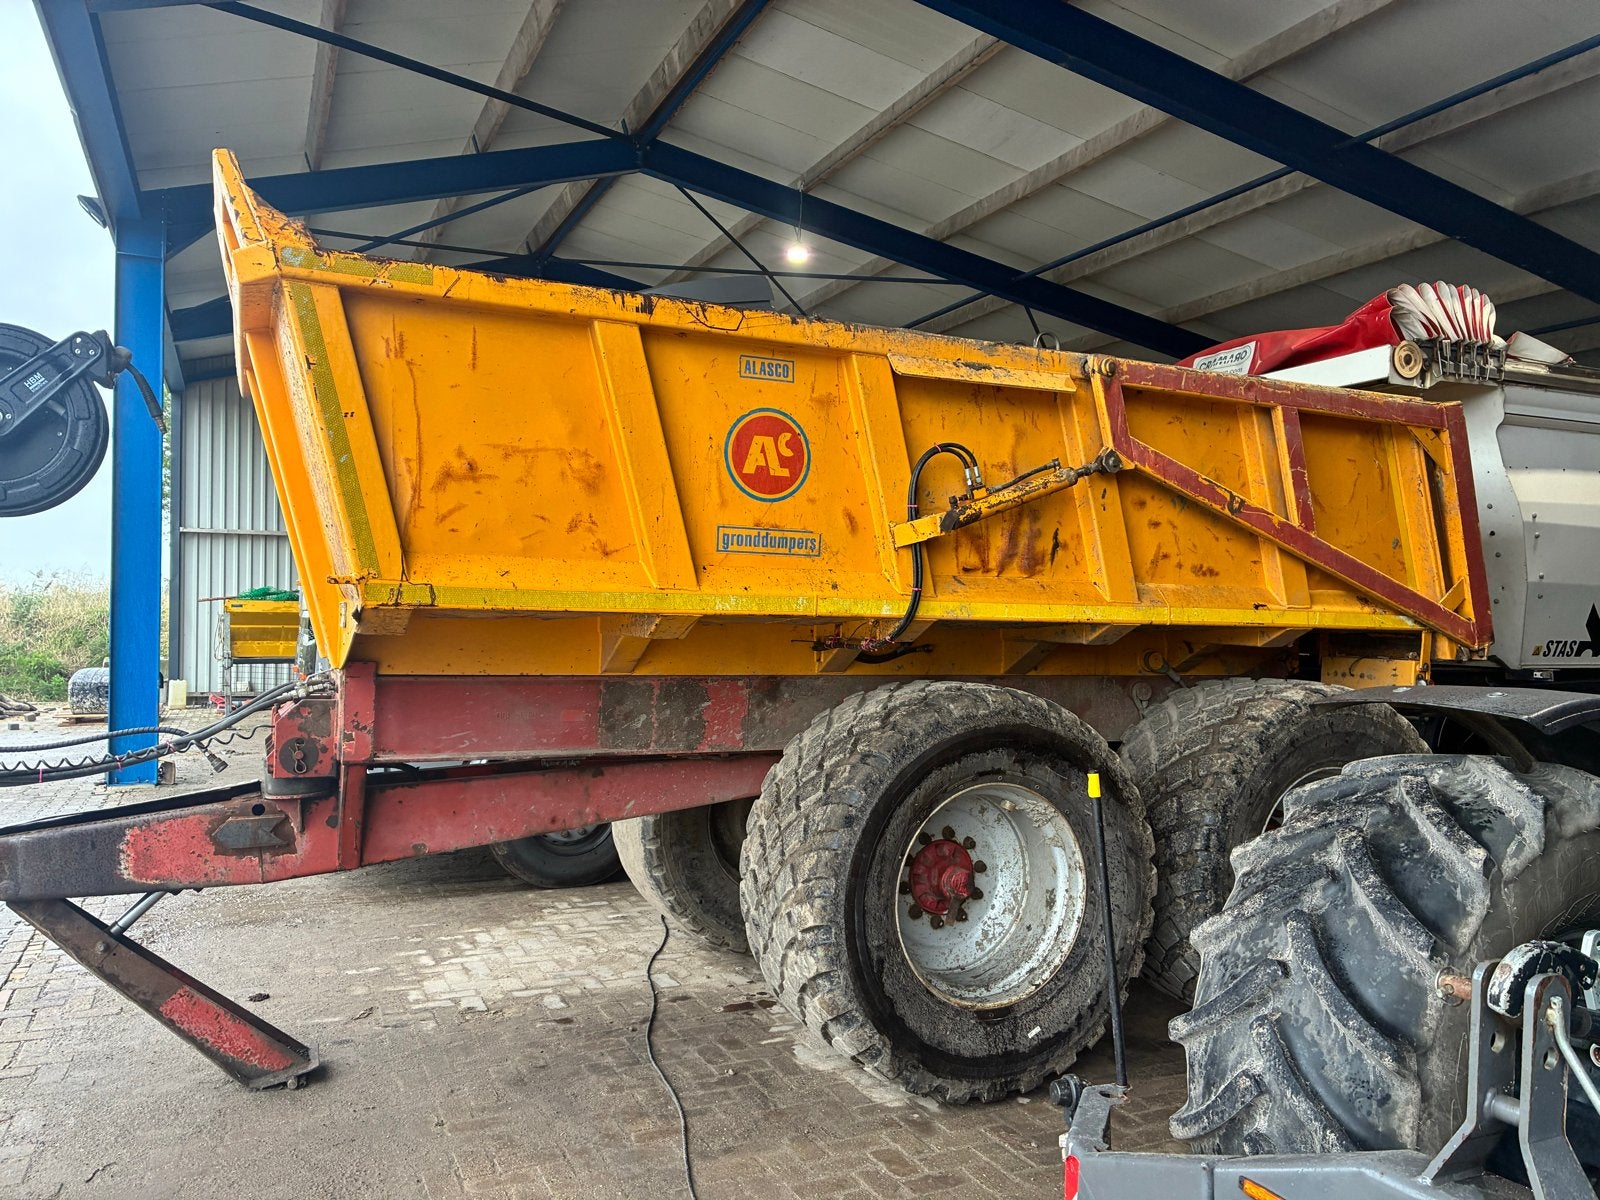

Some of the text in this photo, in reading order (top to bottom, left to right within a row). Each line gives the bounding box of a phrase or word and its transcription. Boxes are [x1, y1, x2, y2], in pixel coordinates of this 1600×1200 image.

[744, 359, 790, 378] ALASCO
[24, 372, 43, 388] HBM
[722, 531, 816, 554] gronddumpers
[1543, 640, 1577, 657] STAS
